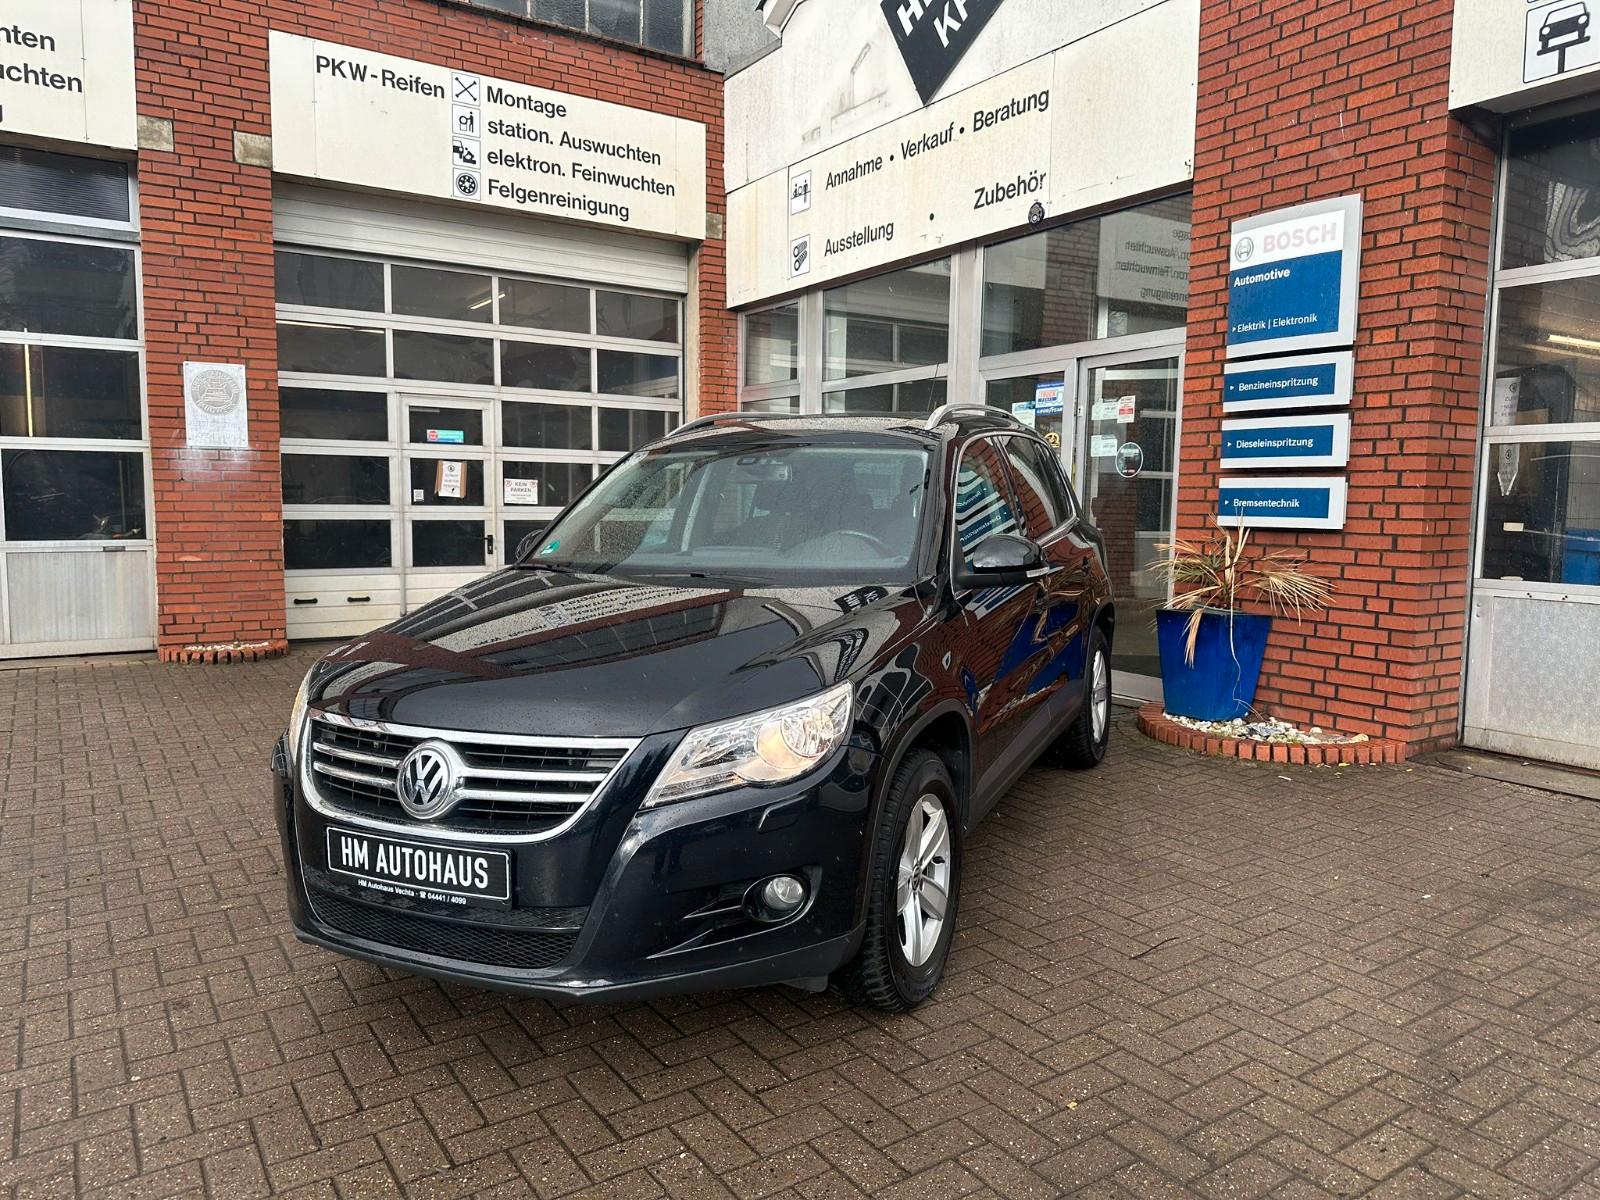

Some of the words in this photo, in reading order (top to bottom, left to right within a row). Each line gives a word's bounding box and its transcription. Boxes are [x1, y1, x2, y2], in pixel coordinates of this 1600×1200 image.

[487, 86, 567, 118] Montage
[487, 119, 554, 145] station.
[559, 131, 661, 165] Auswuchten
[825, 156, 883, 190] Annahme
[901, 121, 955, 160] Verkauf
[973, 89, 1050, 132] Beratung
[487, 149, 566, 176] elektron.
[572, 162, 675, 196] Feinwuchten
[488, 178, 630, 222] Felgenreinigung
[973, 170, 1047, 210] Zubehör
[824, 222, 894, 257] Ausstellung
[1263, 222, 1337, 253] BOSCH
[1233, 267, 1291, 287] Automotive
[1237, 320, 1266, 333] Elektrik
[1272, 311, 1318, 328] Elektronik
[1238, 377, 1319, 391] Benzineinspritzung
[1236, 438, 1314, 449] Dieseleinspritzung
[1233, 498, 1300, 508] Bremsentechnik
[341, 836, 369, 871] HM
[375, 843, 489, 889] AUTOHAUS
[358, 879, 367, 888] HM
[367, 881, 394, 893] Autohaus
[394, 886, 415, 897] Vechta
